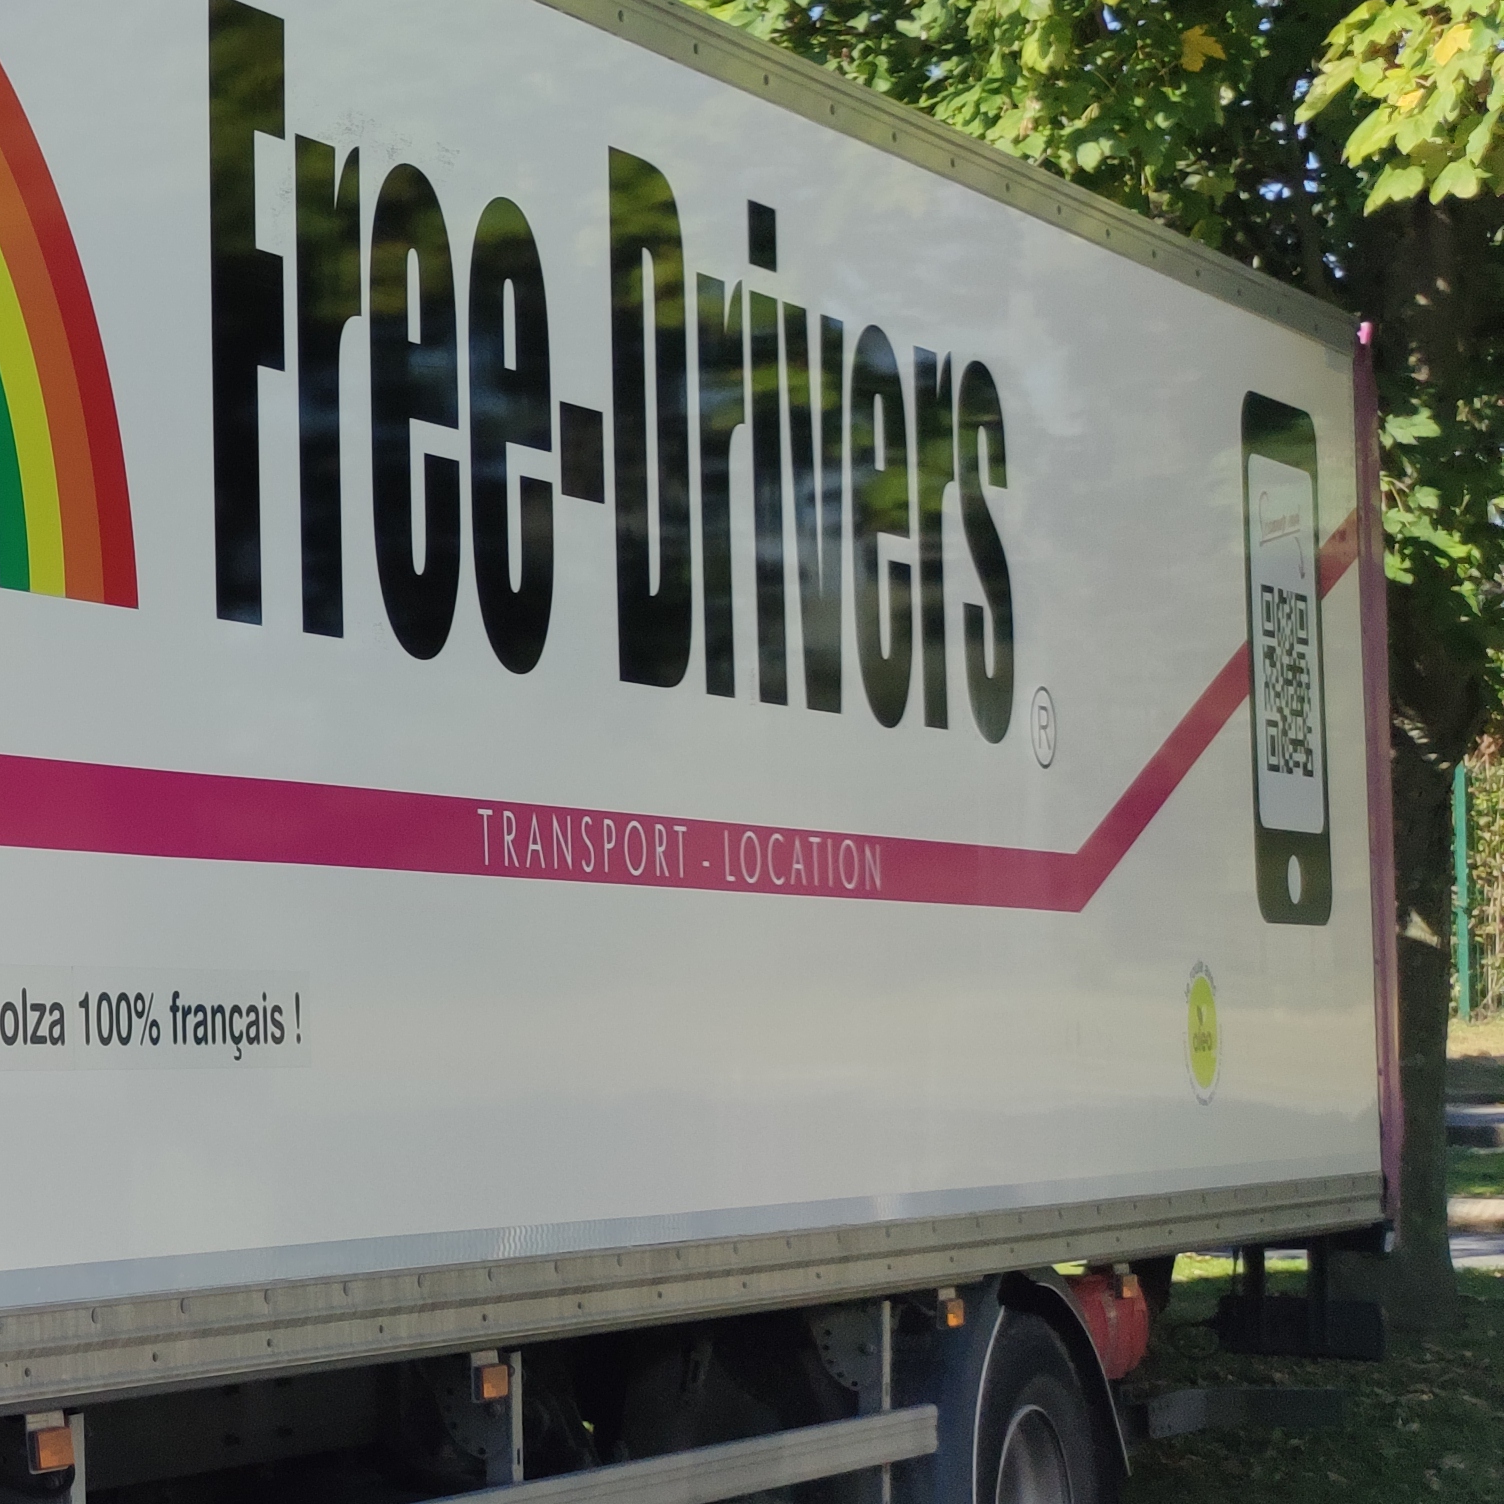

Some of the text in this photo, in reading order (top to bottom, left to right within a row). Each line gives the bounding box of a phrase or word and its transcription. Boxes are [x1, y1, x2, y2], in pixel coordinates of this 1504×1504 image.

[477, 808, 688, 879] TRANSPORT
[724, 829, 882, 892] LOCATION
[78, 991, 161, 1047] 100%
[169, 990, 286, 1061] français
